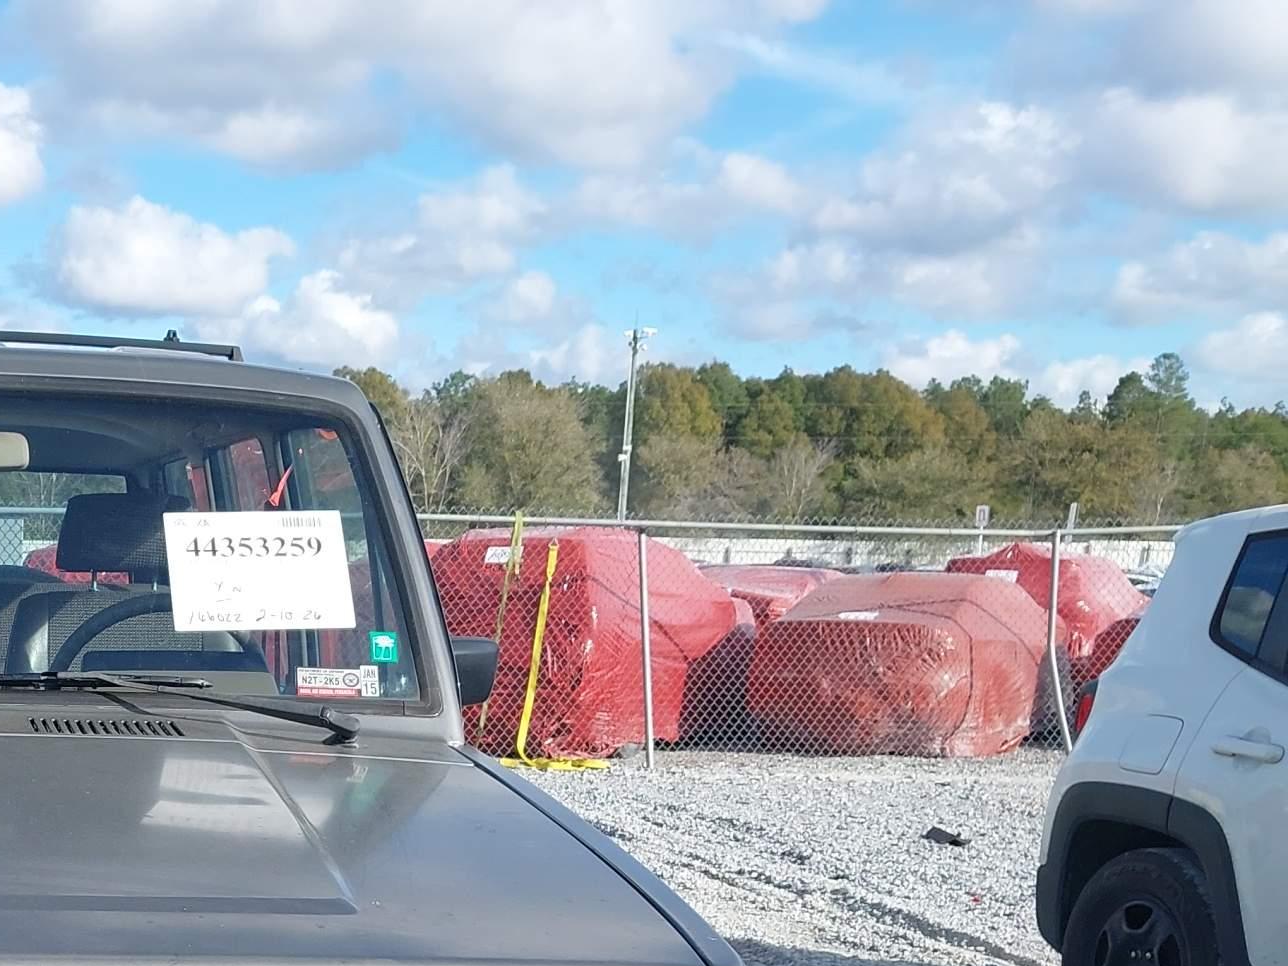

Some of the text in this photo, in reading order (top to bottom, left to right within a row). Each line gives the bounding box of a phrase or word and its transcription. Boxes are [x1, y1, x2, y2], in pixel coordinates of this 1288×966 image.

[186, 536, 322, 557] 44353259
[362, 668, 377, 679] JAN
[301, 676, 341, 686] N2T-2K5
[362, 682, 378, 695] 15
